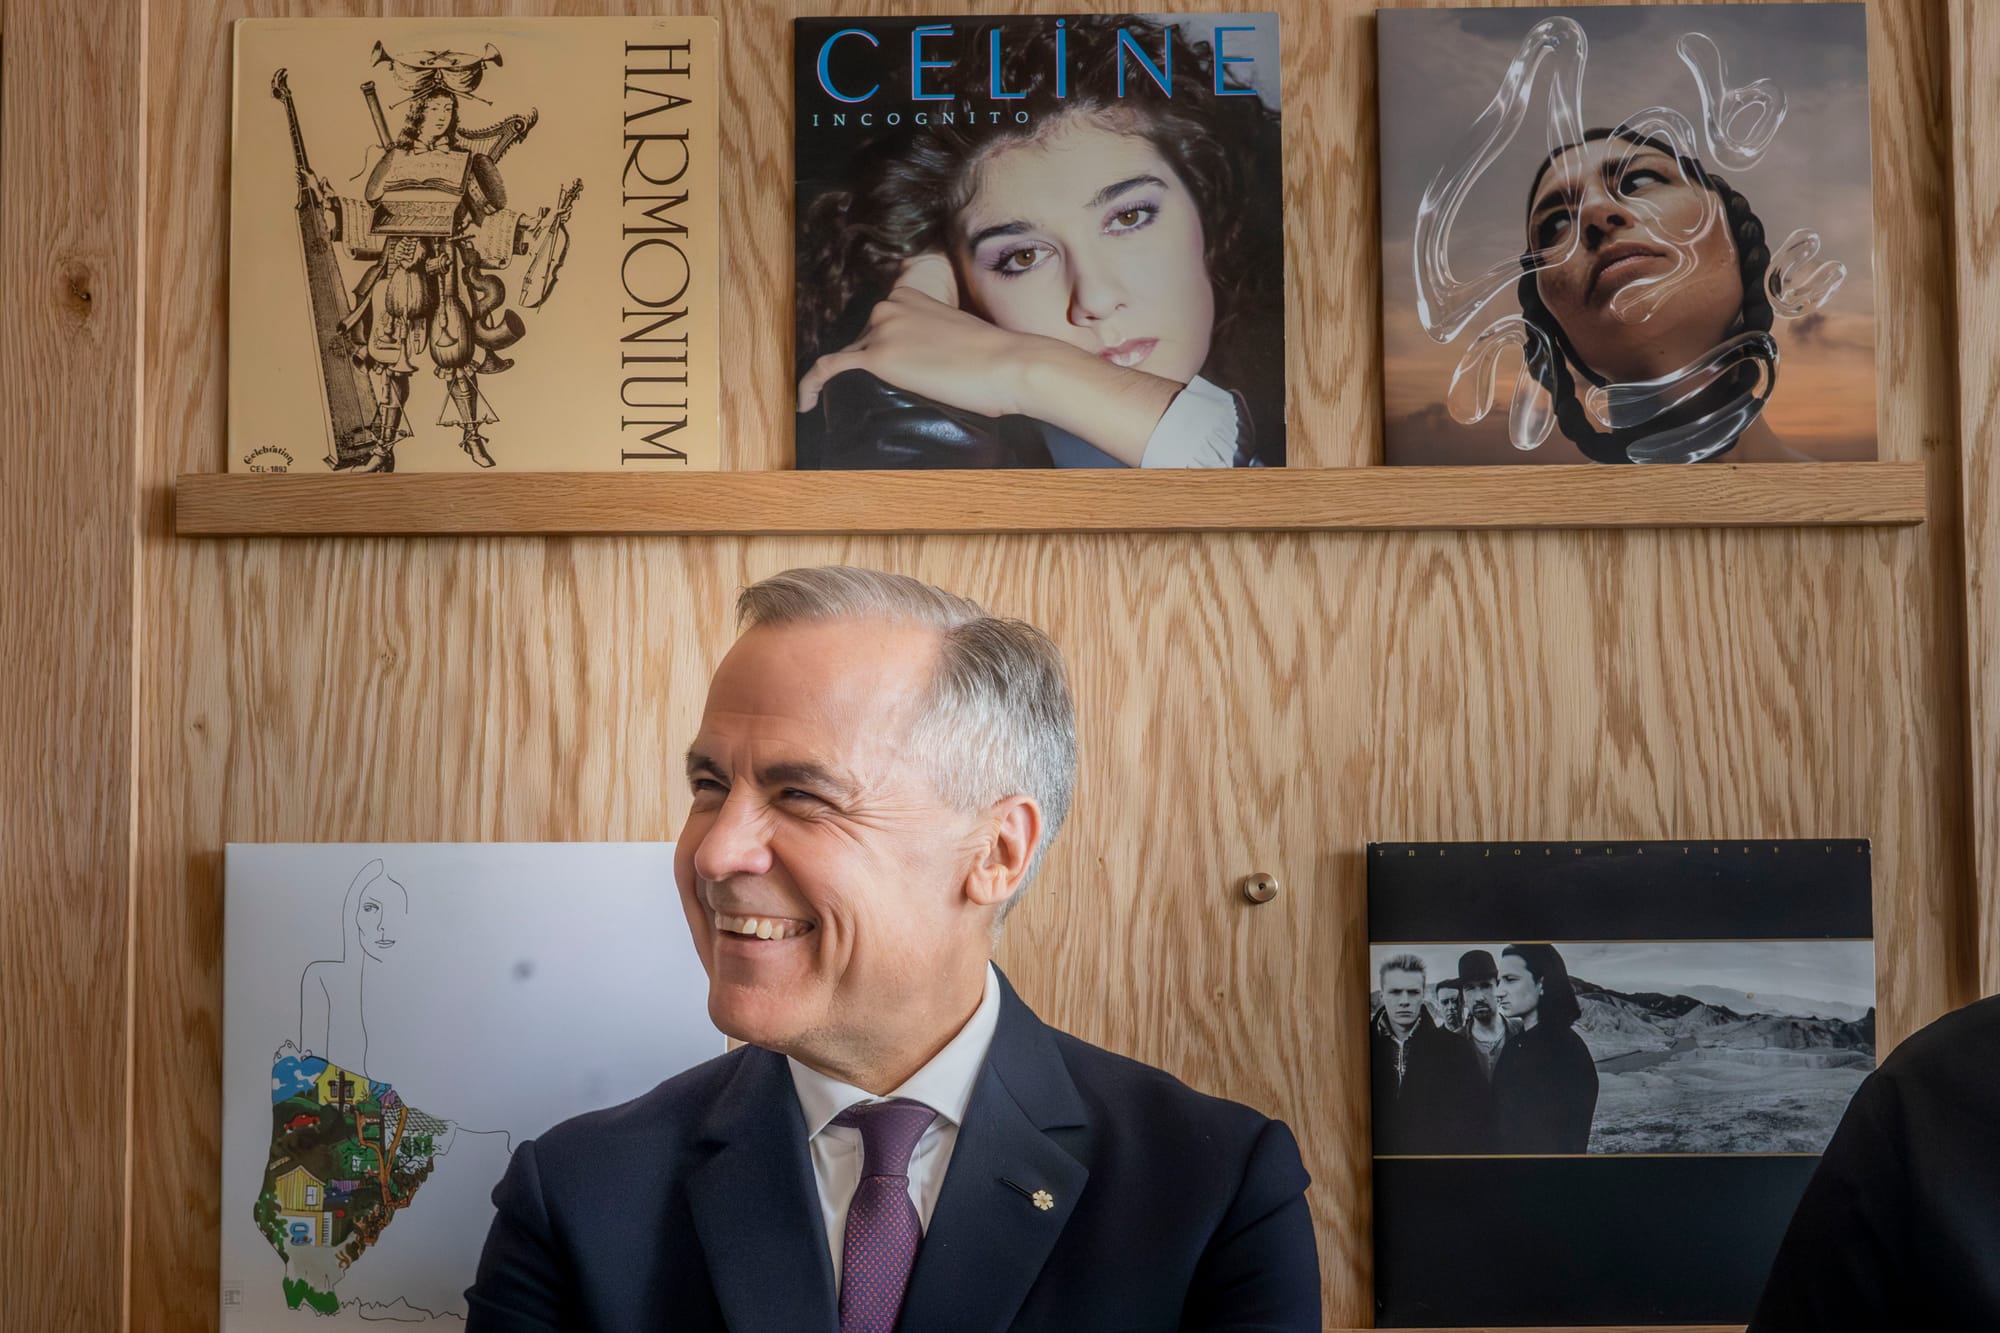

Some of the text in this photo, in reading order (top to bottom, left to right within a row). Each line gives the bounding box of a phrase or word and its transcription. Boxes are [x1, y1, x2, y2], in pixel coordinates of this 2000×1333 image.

[812, 111, 1029, 127] INCOGNITO
[619, 39, 693, 465] HARMONIUM
[1377, 848, 1446, 857] THE
[1483, 847, 1644, 857] JOSHUA
[1682, 846, 1780, 855] TREE
